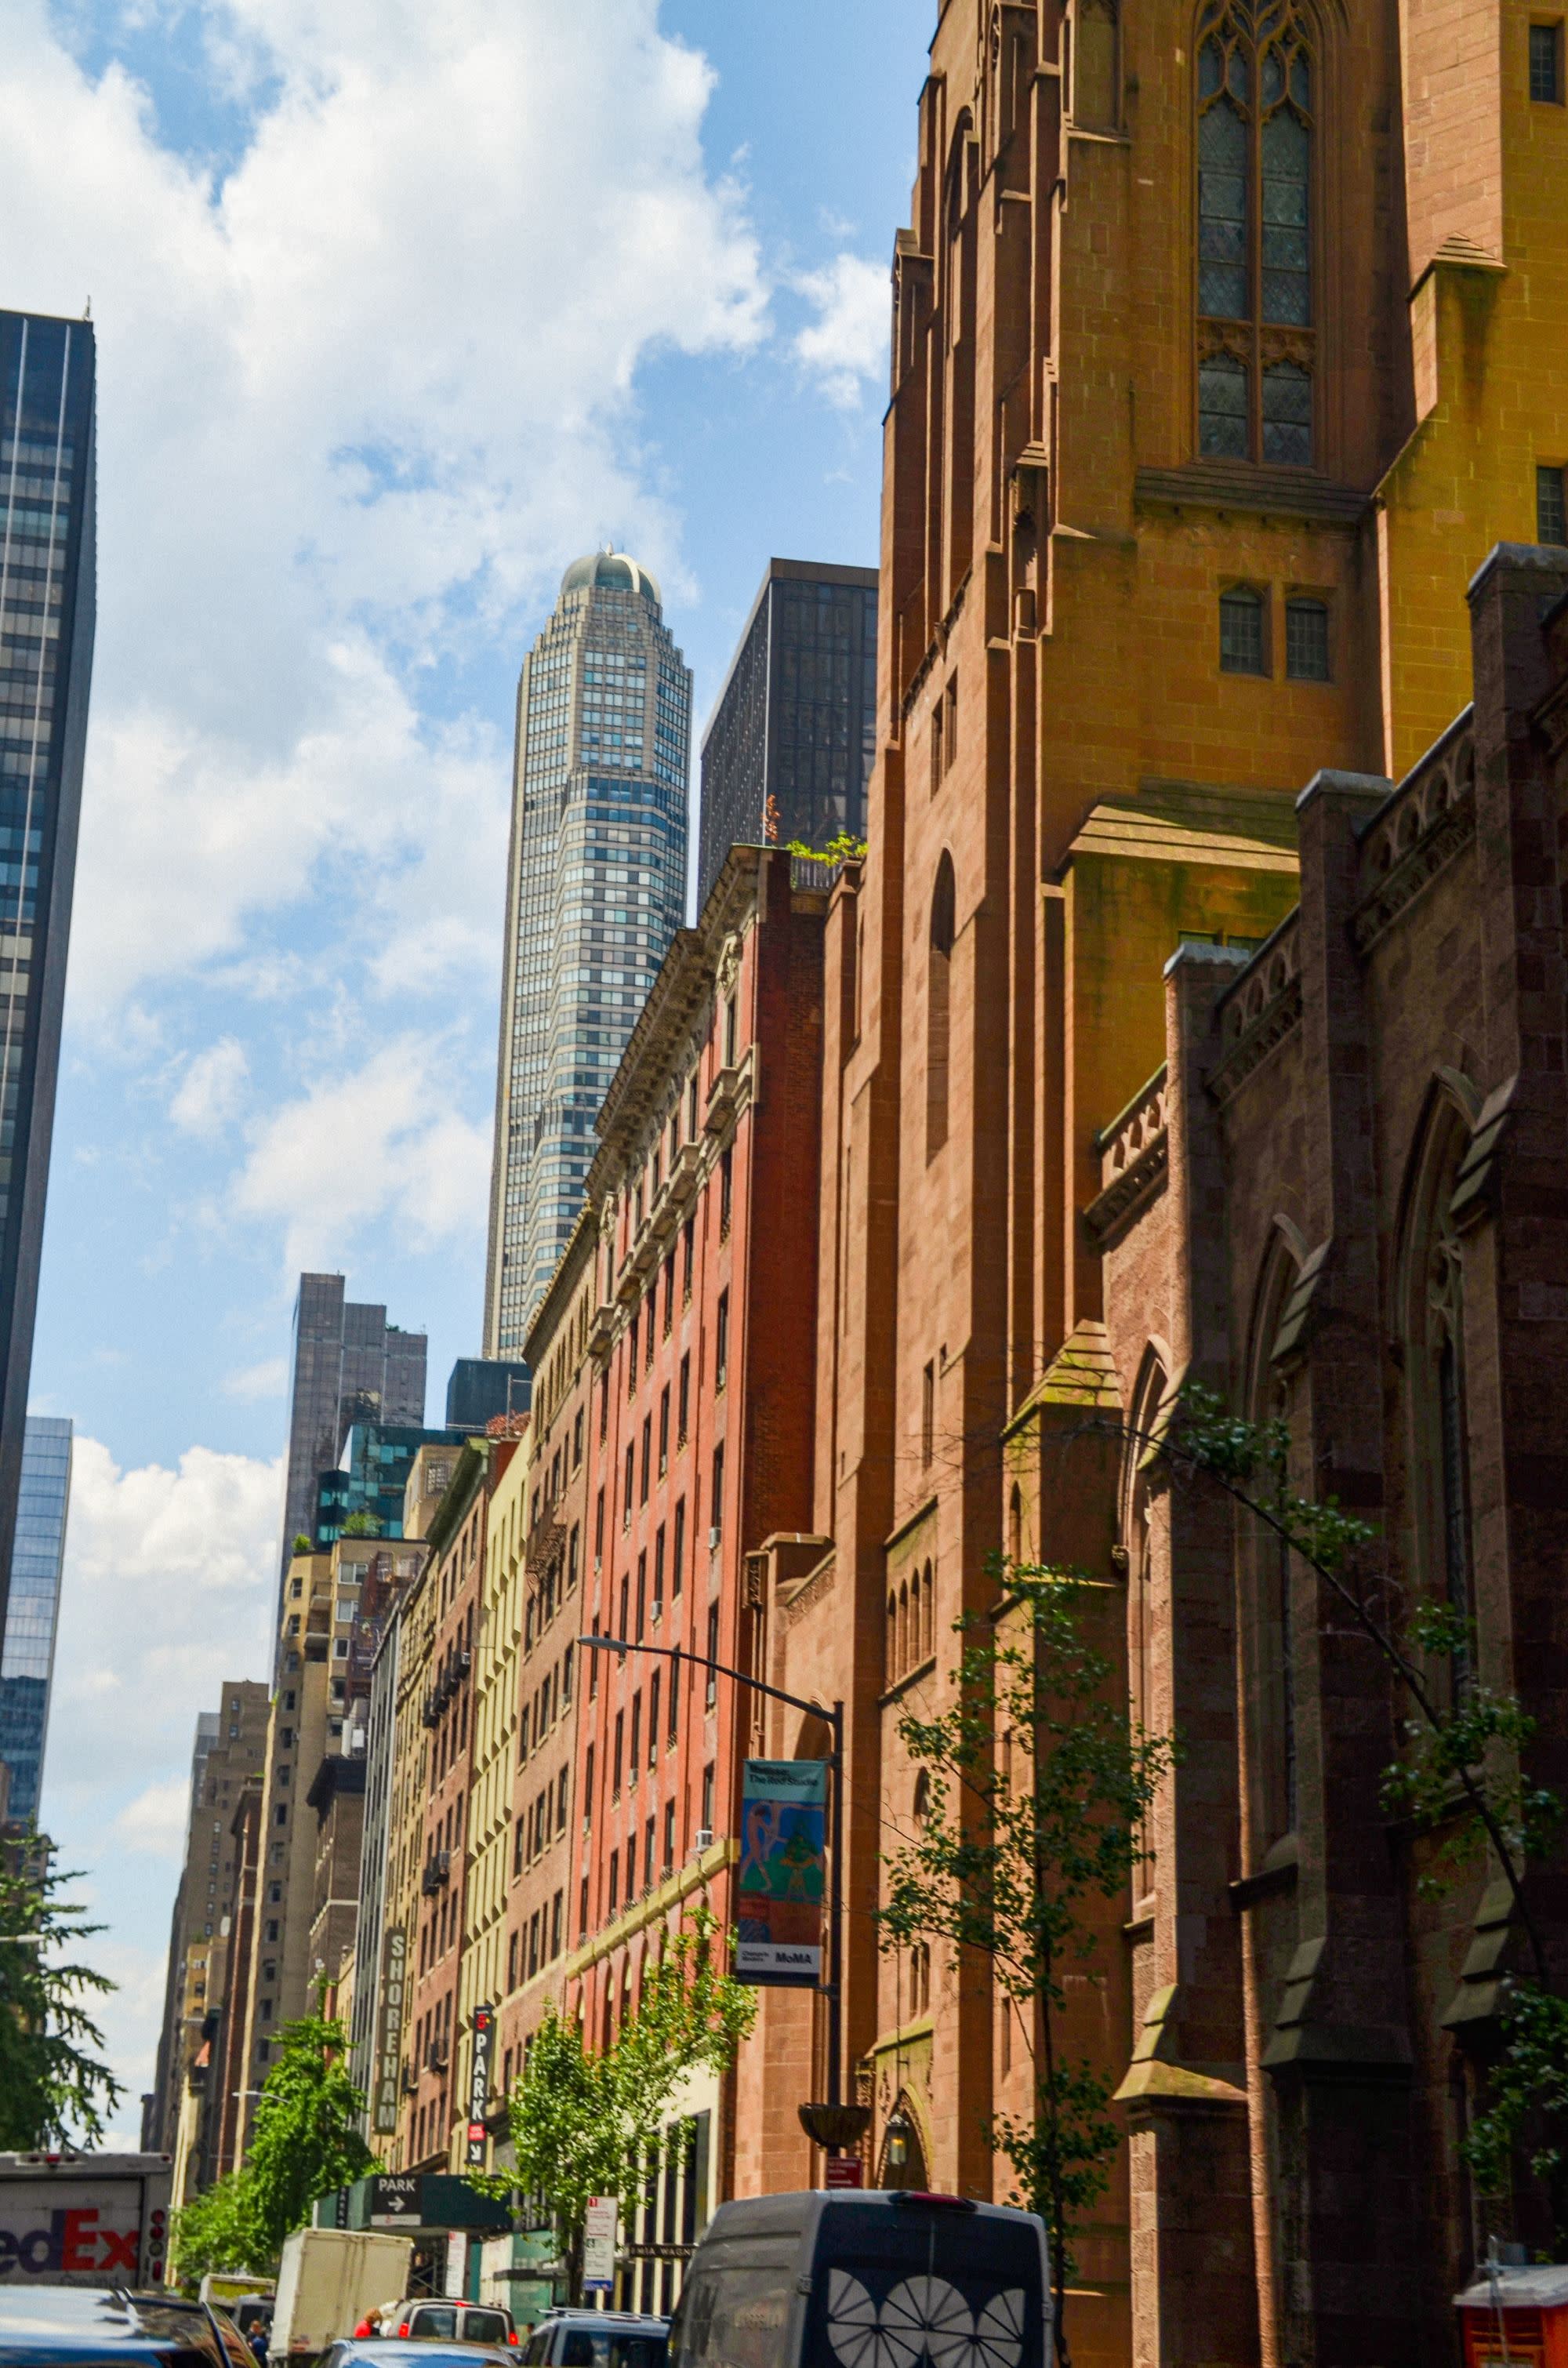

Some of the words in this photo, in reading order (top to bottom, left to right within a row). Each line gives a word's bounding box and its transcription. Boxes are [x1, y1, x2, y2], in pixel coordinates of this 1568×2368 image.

[775, 1952, 812, 1964] MoMA
[379, 1935, 405, 2127] SHOREHAM
[472, 2033, 487, 2120] PARK
[379, 2178, 416, 2192] PARK
